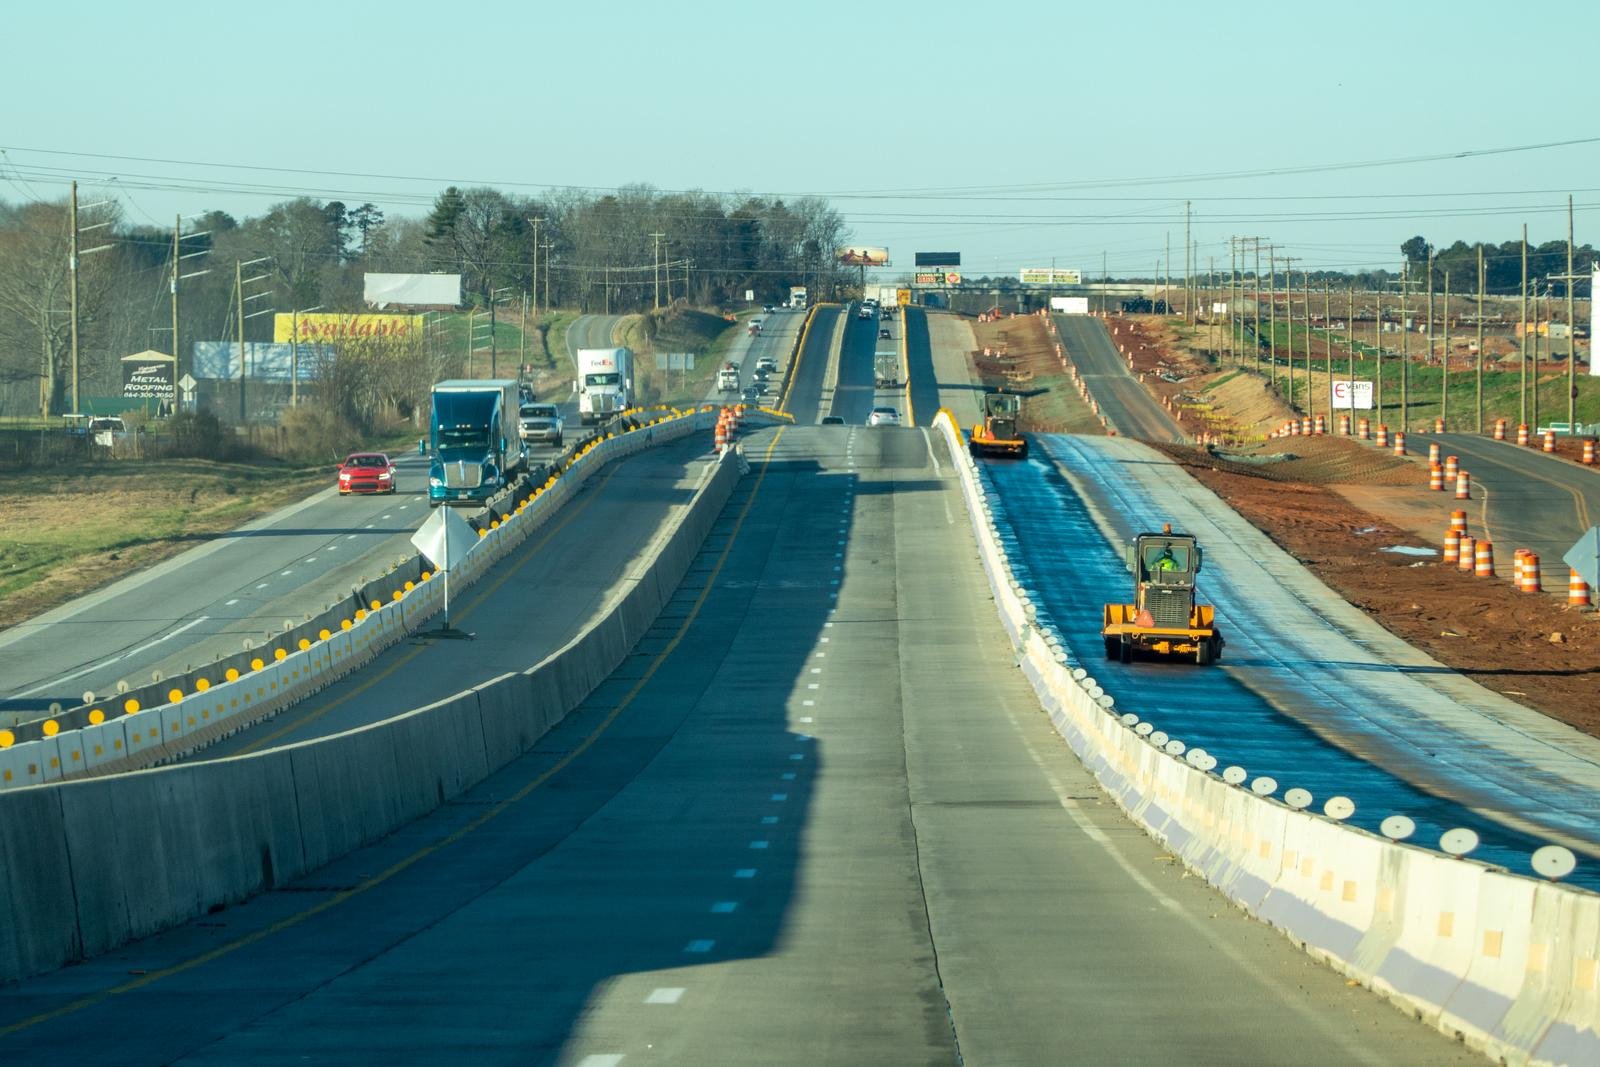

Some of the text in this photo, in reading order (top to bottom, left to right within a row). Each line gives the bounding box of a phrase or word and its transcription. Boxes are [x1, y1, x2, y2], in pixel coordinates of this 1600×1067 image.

[297, 318, 409, 337] Available
[591, 359, 613, 367] FedEx
[1335, 383, 1370, 398] Evans
